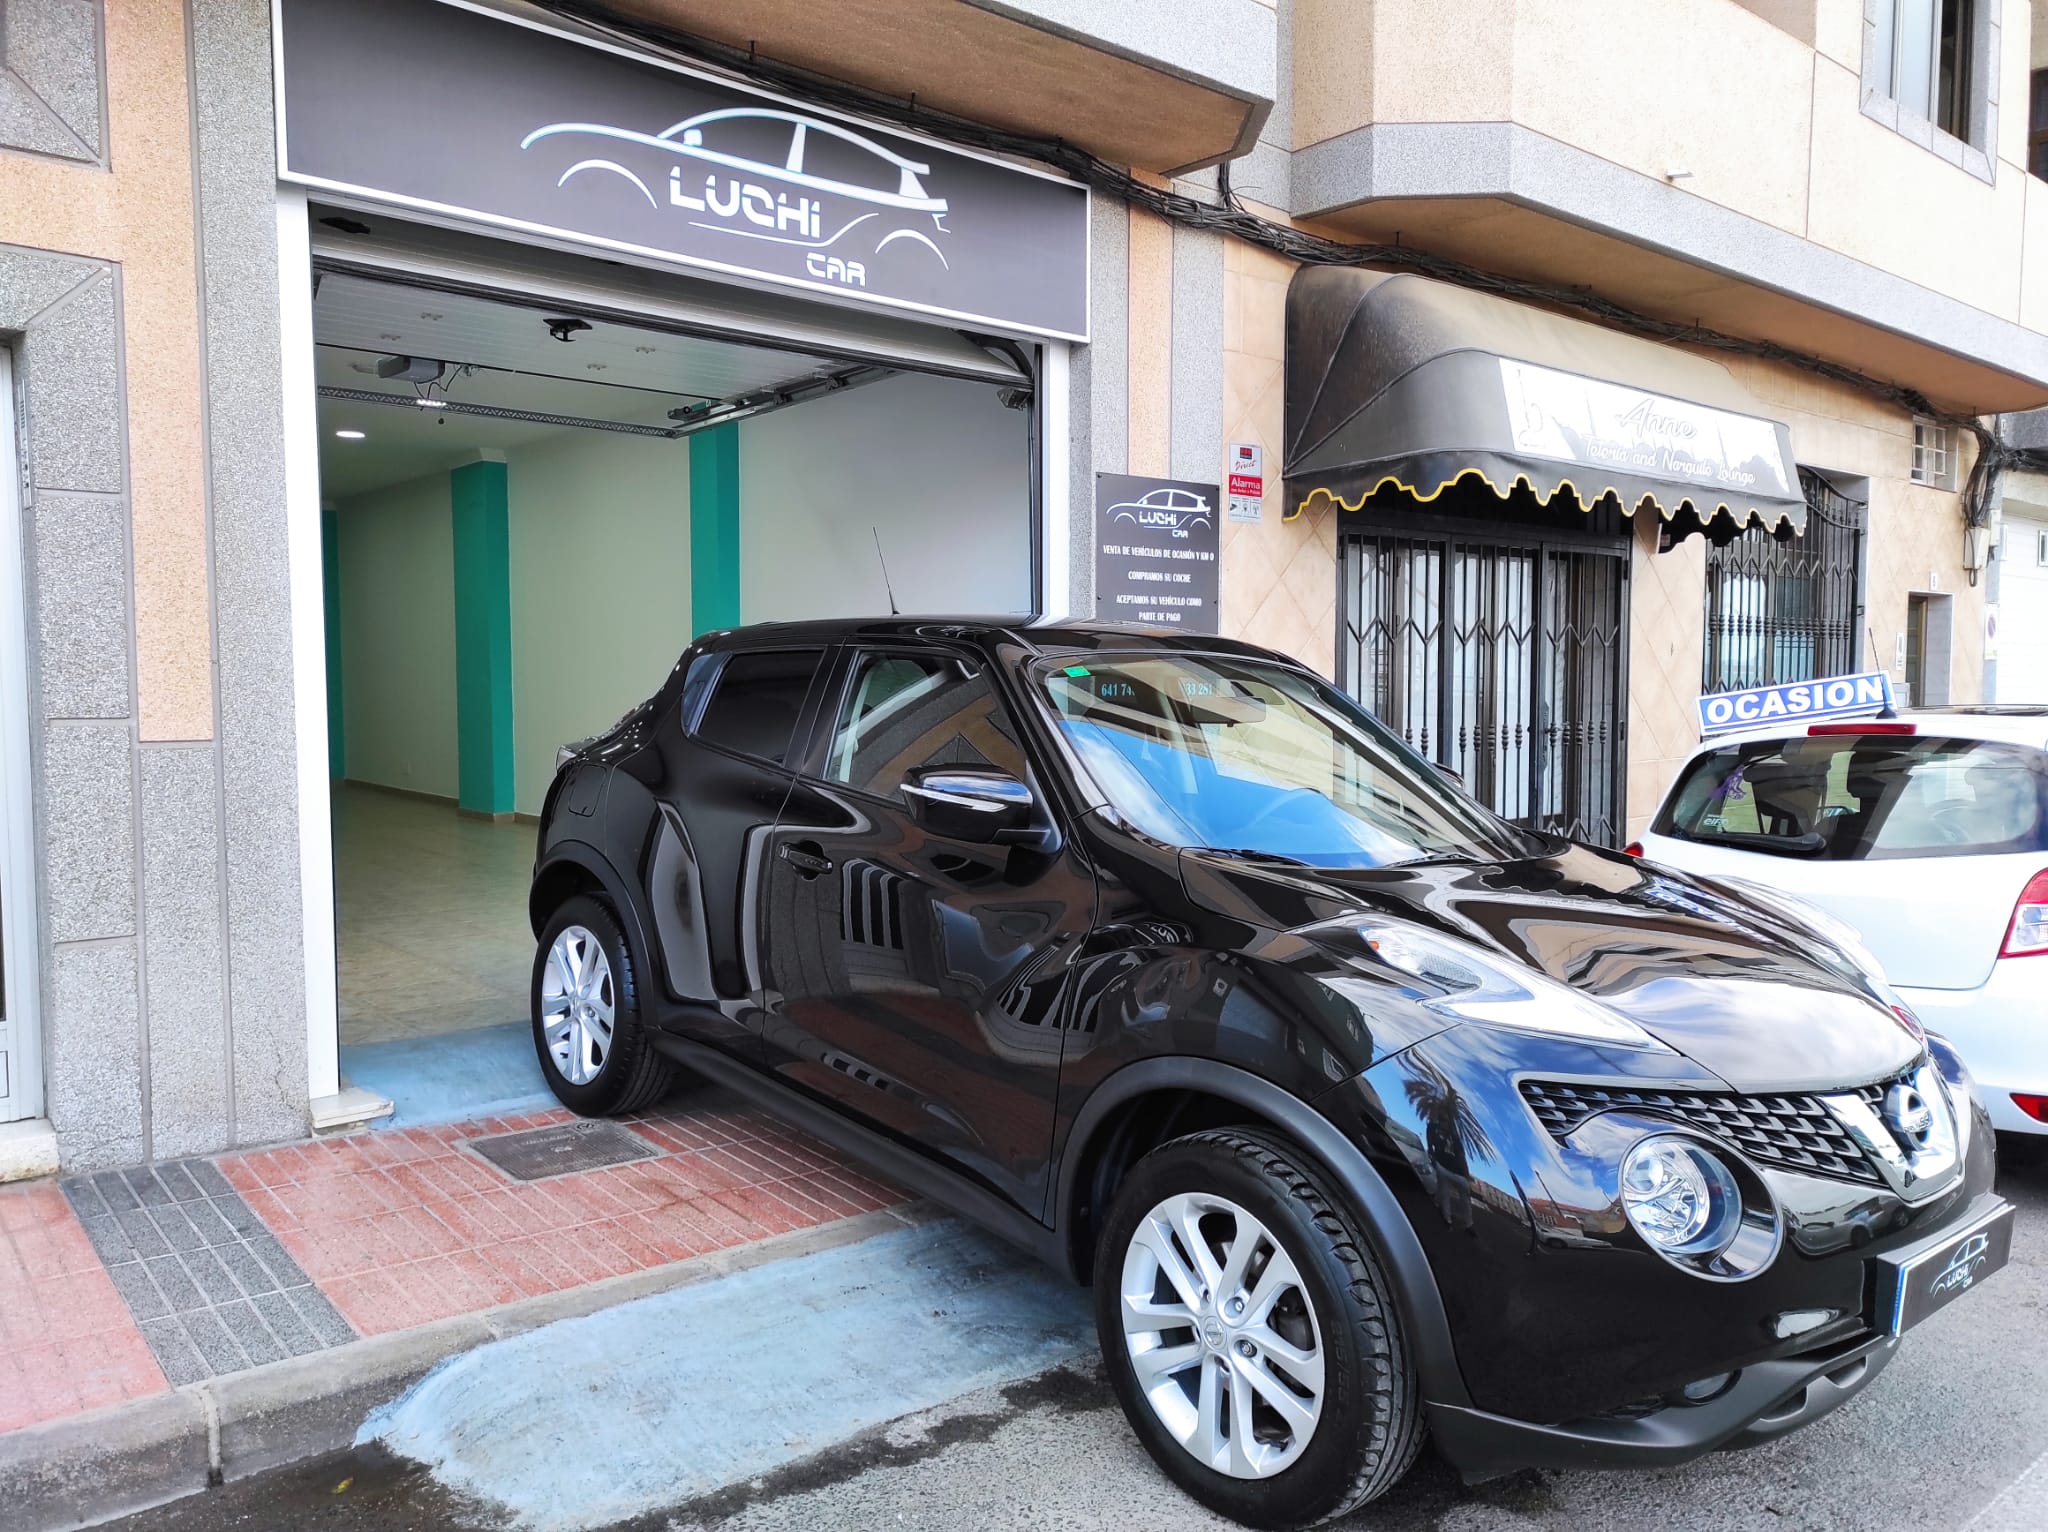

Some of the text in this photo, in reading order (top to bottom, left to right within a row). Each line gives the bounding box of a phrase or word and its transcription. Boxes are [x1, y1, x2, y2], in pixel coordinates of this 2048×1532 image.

[806, 252, 867, 286] CAR
[1633, 451, 1658, 467] and
[1231, 477, 1261, 489] Alarma
[1172, 529, 1189, 538] CAR
[1103, 544, 1121, 554] VENTA
[1122, 546, 1131, 555] DE
[1163, 549, 1171, 558] DE
[1172, 548, 1195, 559] OCASIÓN
[1200, 552, 1209, 560] KM
[1128, 571, 1191, 583] COMPRAMOS SU COCHE
[1116, 594, 1149, 604] ACEPTAMOS
[1150, 596, 1158, 605] SU
[1186, 598, 1202, 607] COMO
[1138, 611, 1181, 622] PARTE DE PAGO
[1706, 676, 1884, 724] OCASION
